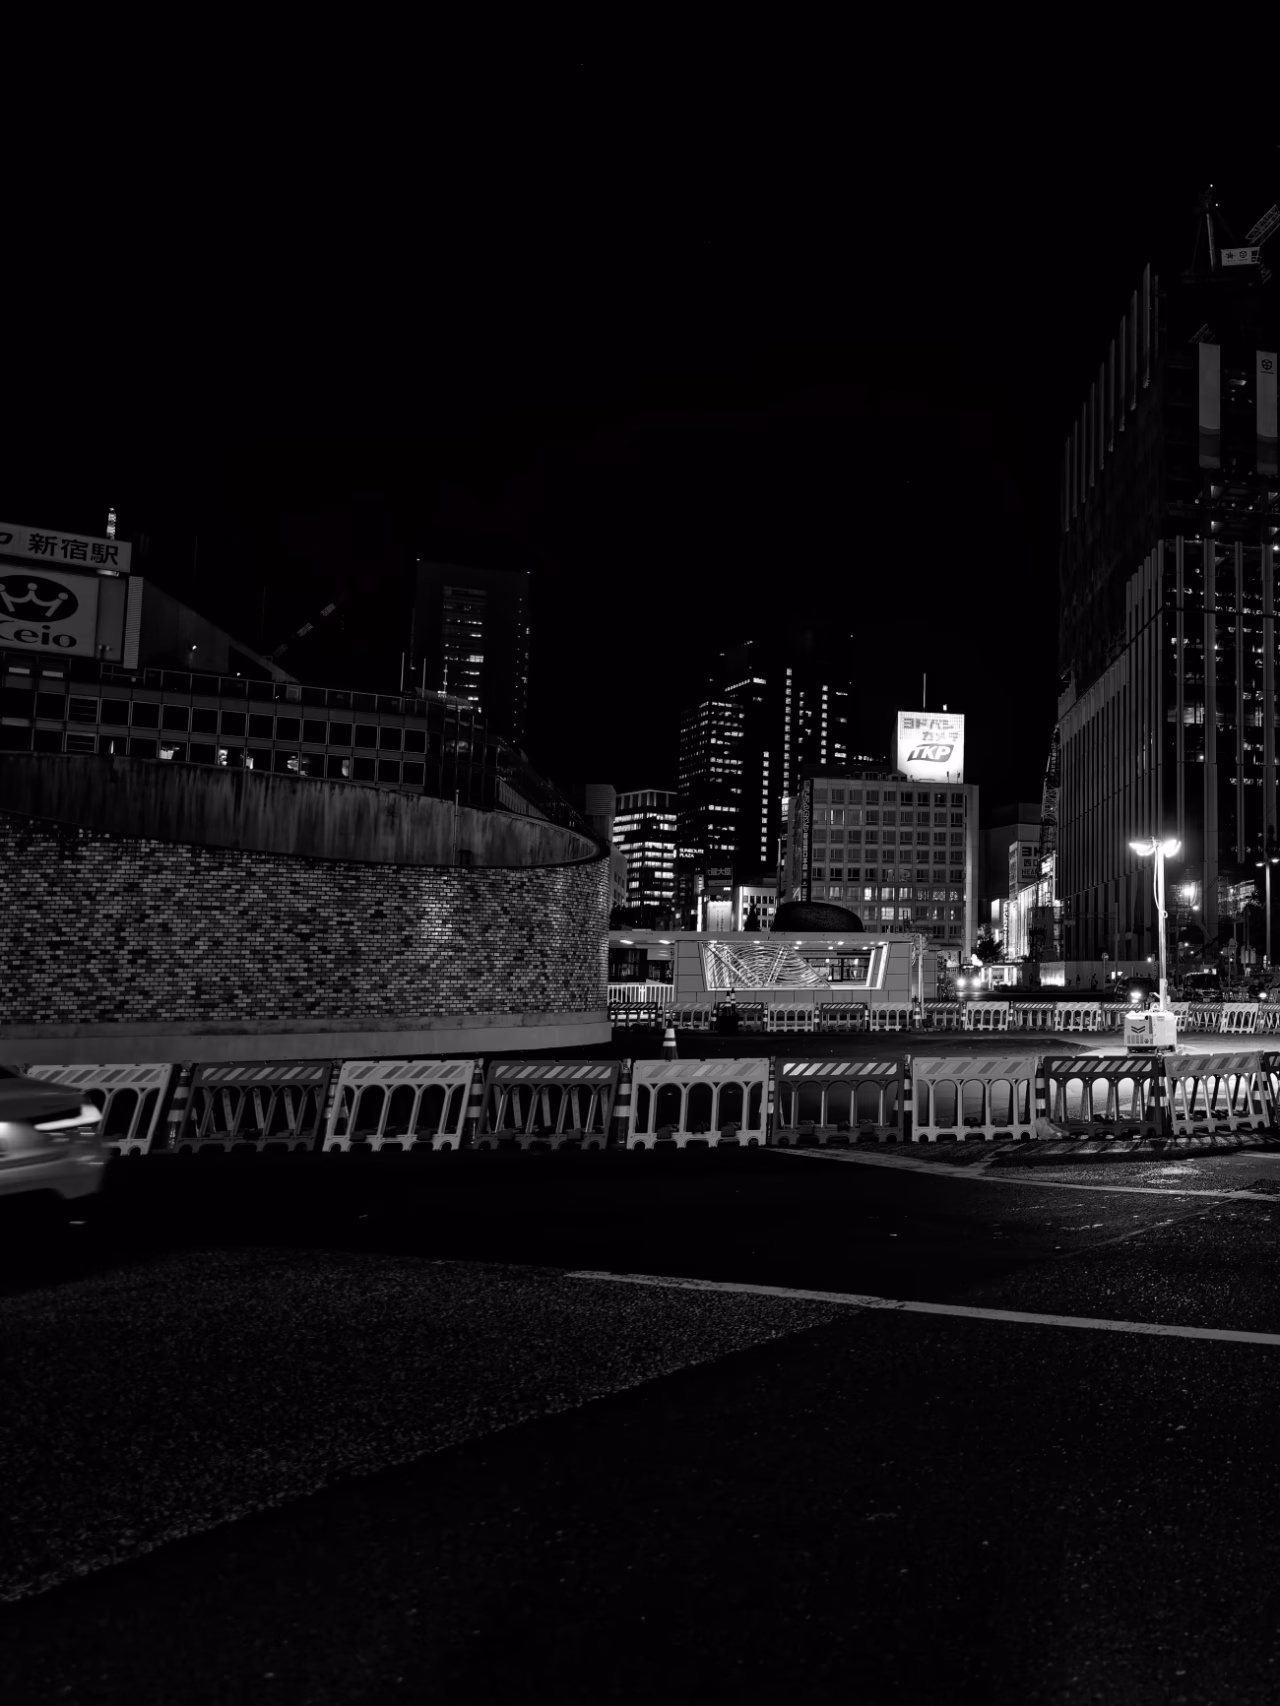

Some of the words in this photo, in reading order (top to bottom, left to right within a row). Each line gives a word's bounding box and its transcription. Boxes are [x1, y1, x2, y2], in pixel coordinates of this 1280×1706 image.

[28, 533, 118, 565] 新宿駅
[908, 744, 953, 761] TKP
